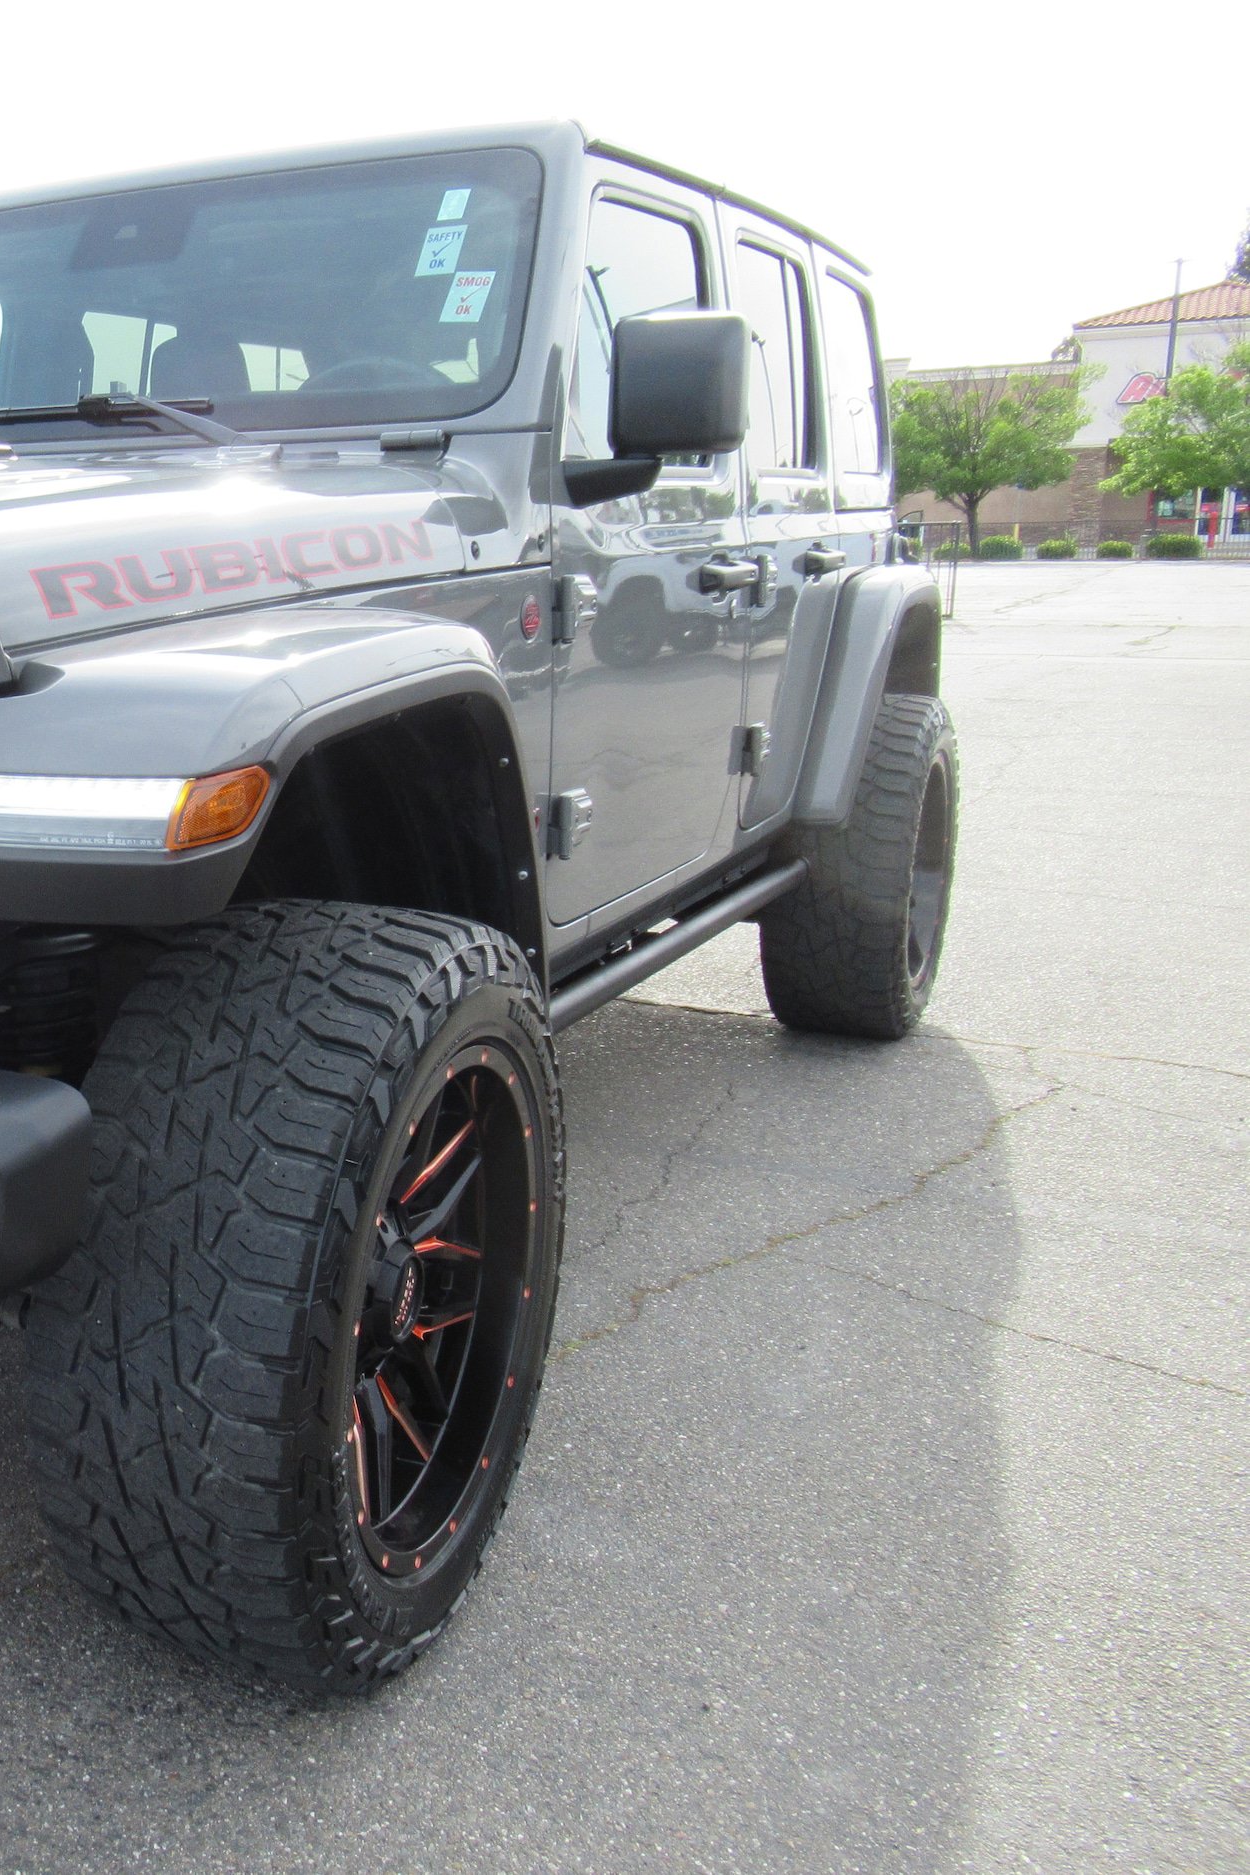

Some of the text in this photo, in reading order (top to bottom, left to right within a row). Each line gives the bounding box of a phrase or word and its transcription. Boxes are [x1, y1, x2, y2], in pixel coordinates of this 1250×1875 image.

[427, 231, 463, 243] SAFETY
[429, 258, 446, 270] OK
[455, 276, 491, 287] SMOG
[455, 304, 472, 315] OK
[29, 518, 437, 620] RUBICON
